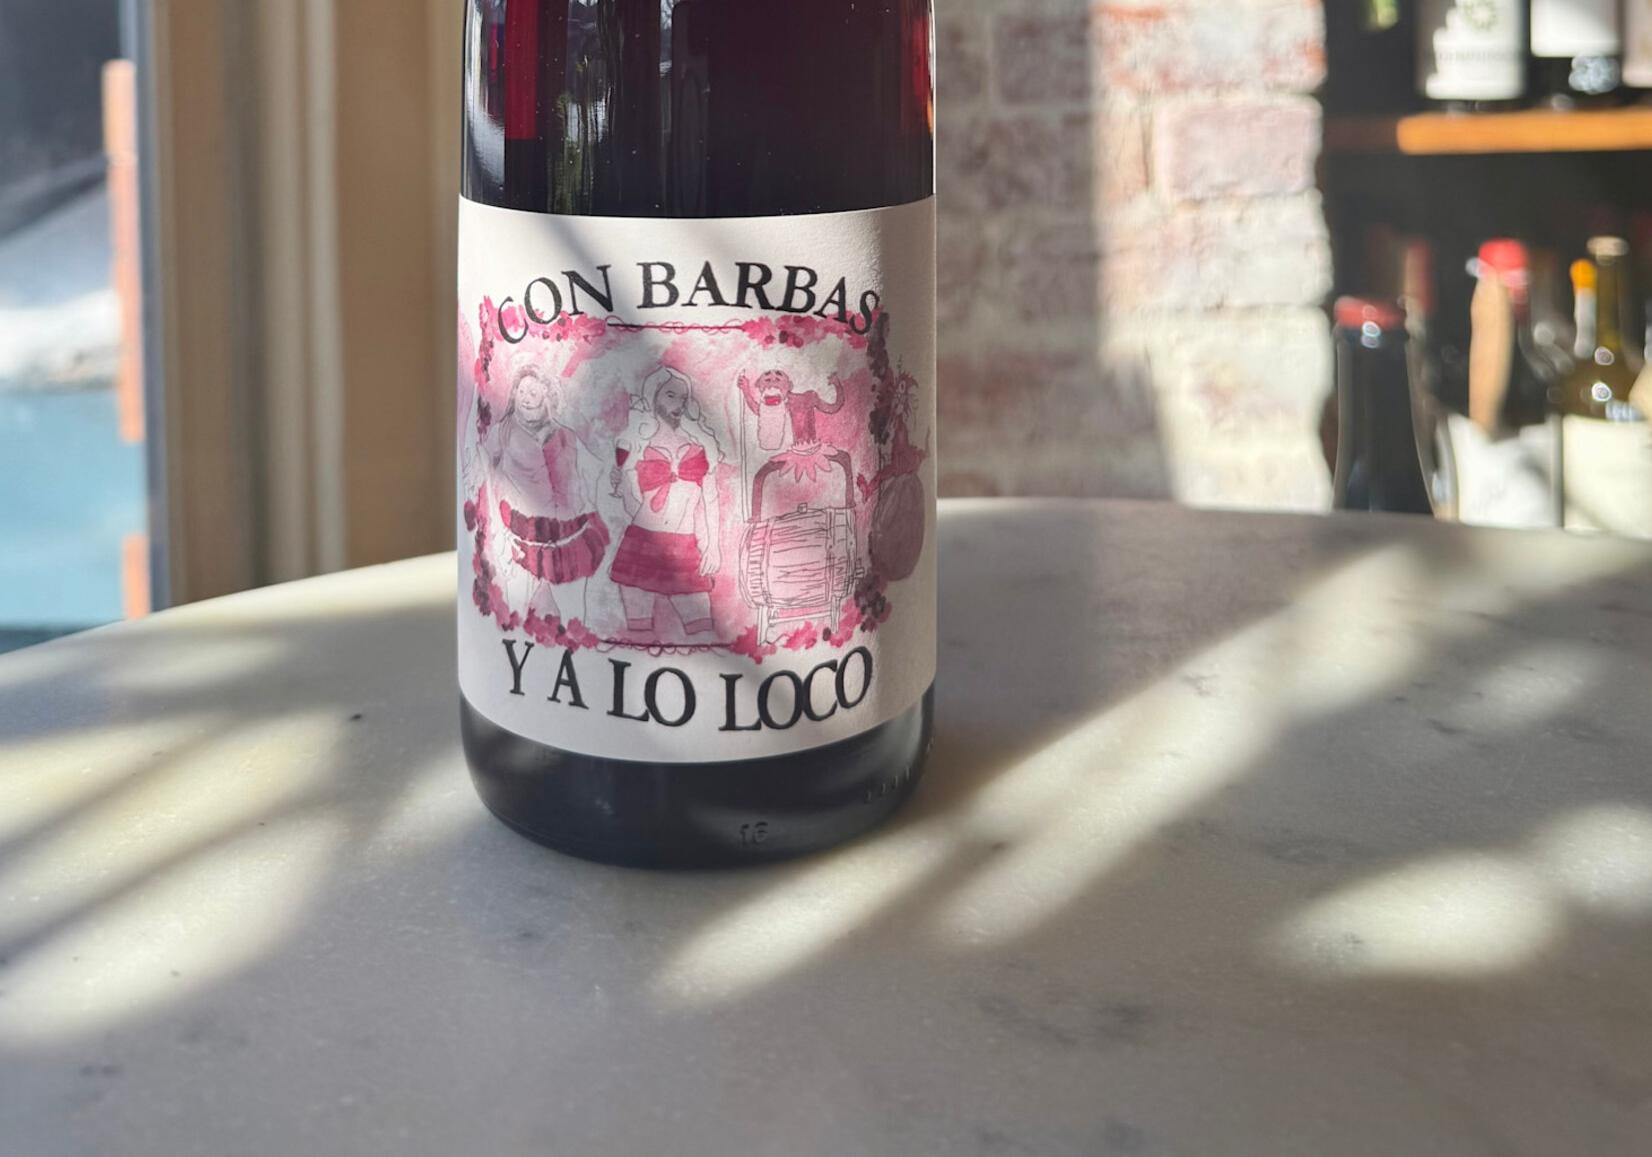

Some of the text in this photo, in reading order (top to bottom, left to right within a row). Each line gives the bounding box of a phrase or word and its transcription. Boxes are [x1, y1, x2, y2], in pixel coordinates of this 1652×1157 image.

[497, 260, 881, 345] CON BARBAS
[502, 638, 874, 732] Y A LO LOCO
